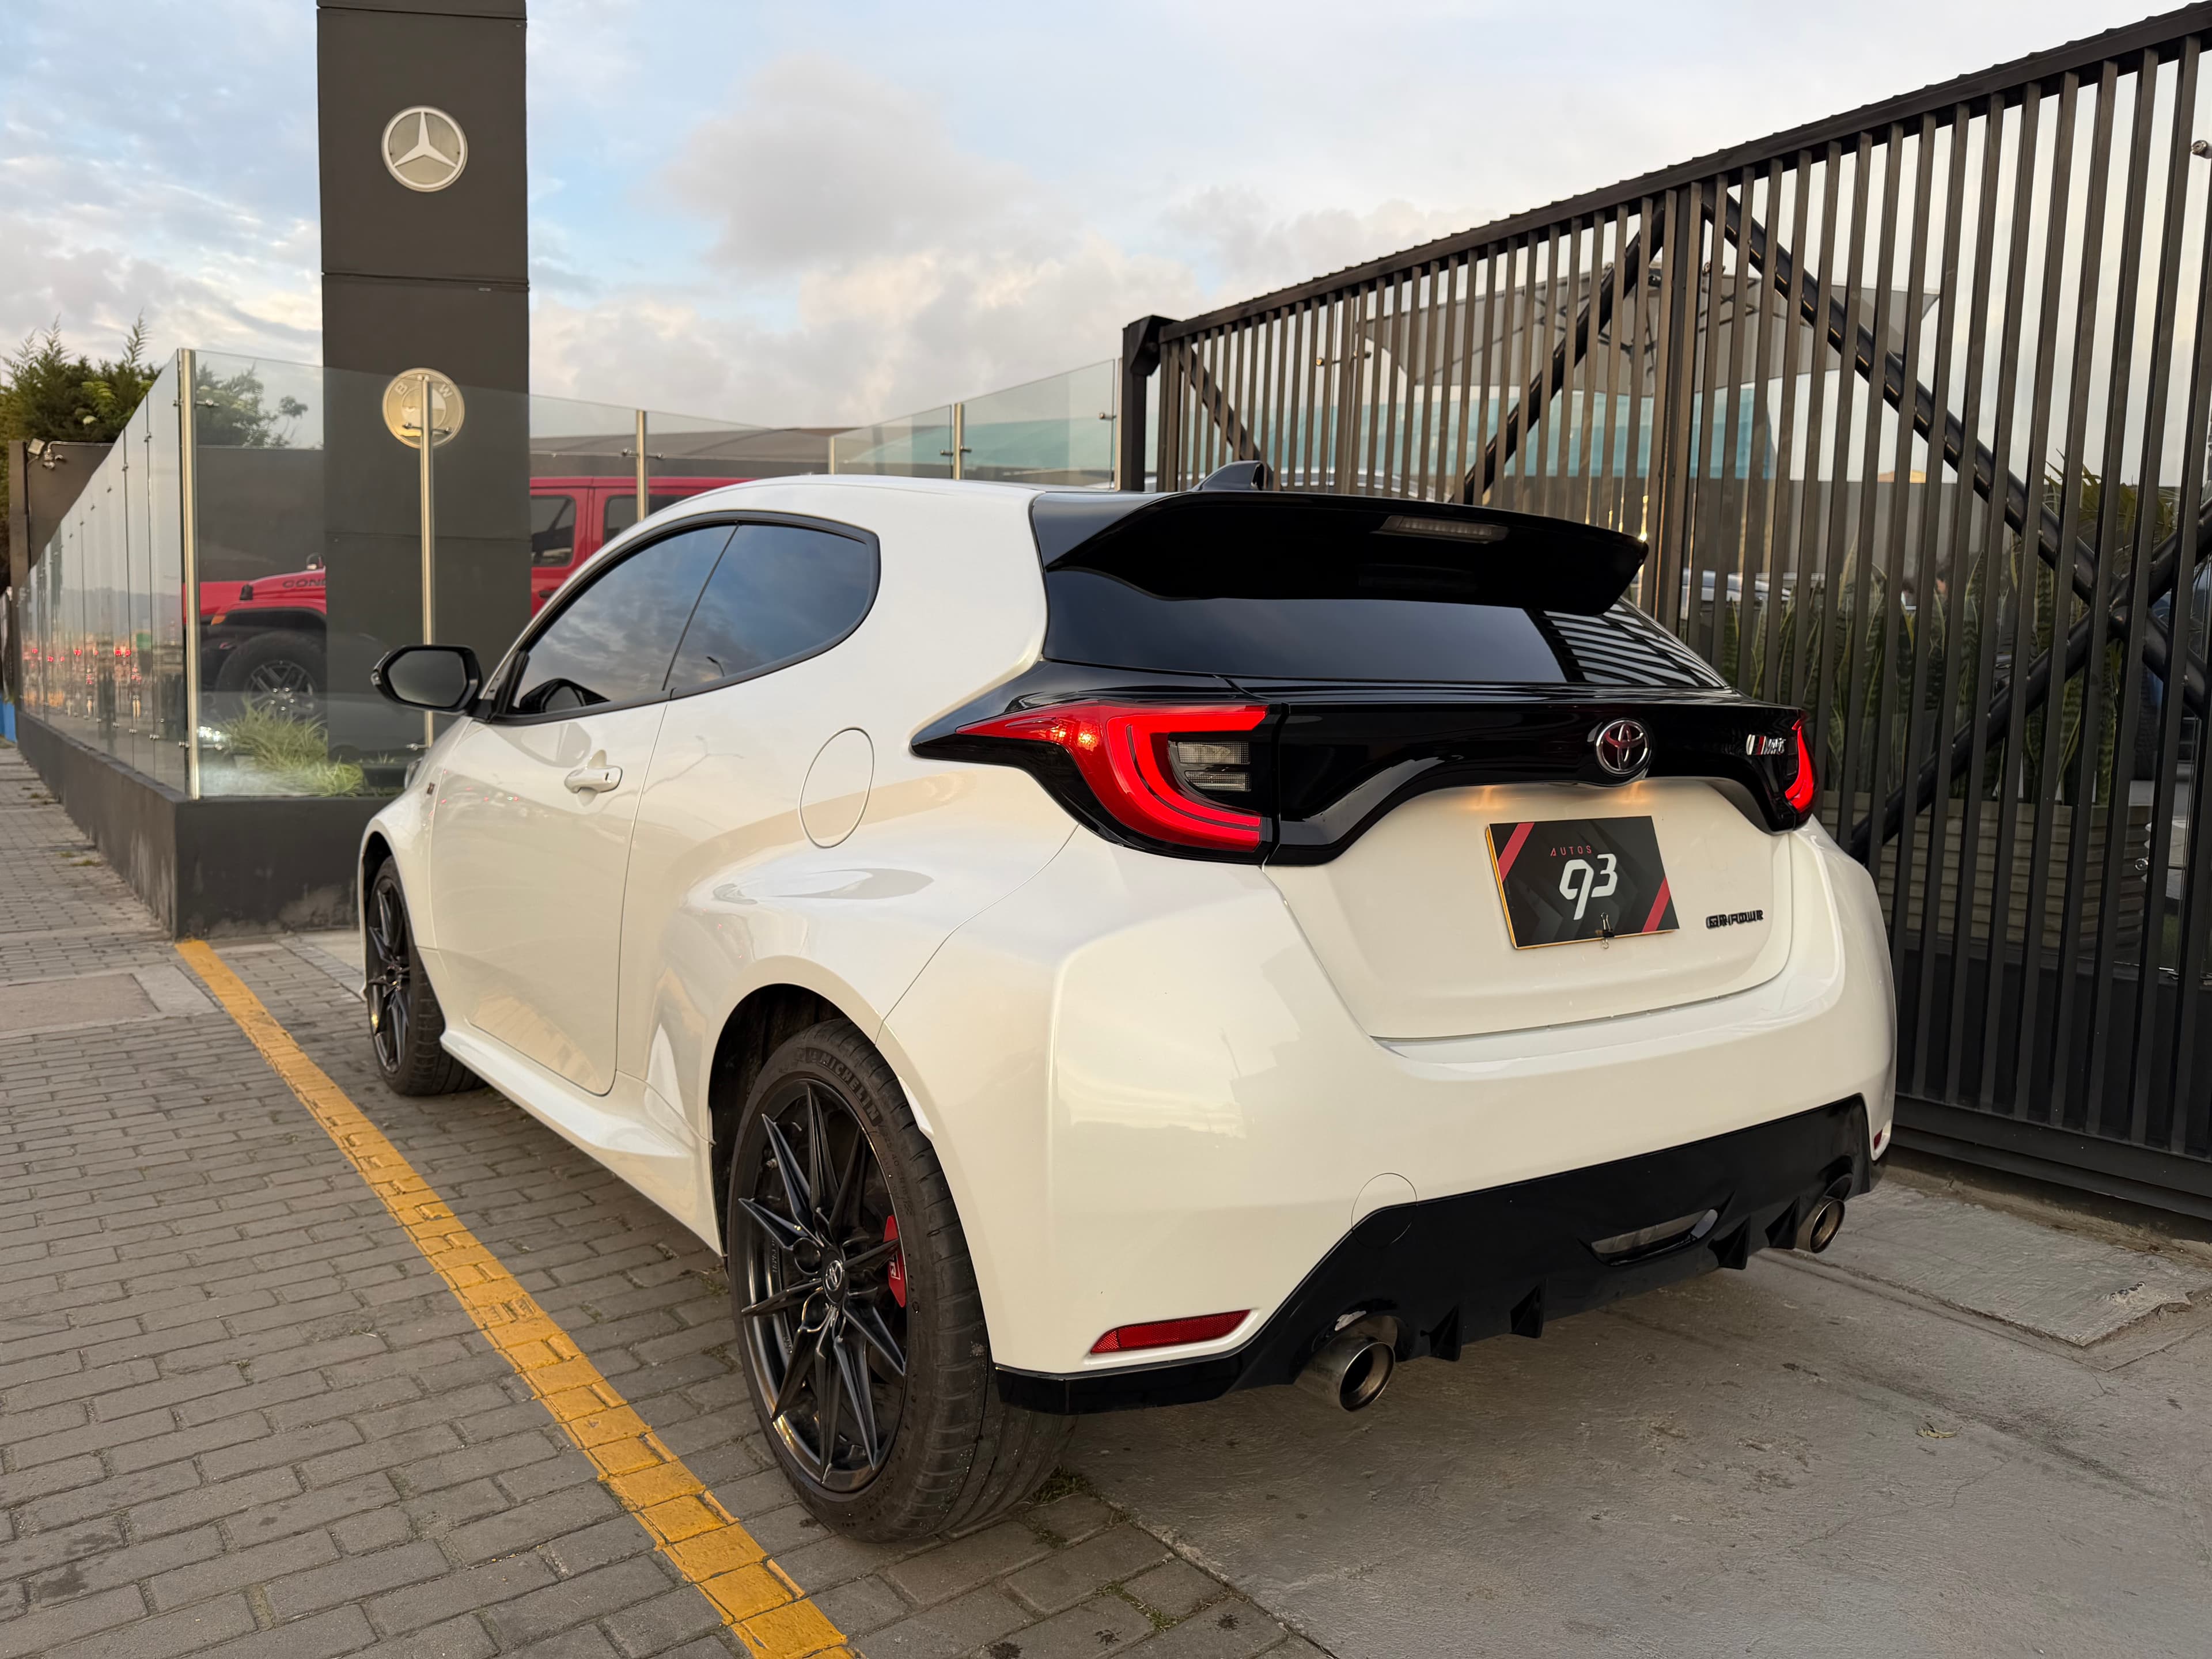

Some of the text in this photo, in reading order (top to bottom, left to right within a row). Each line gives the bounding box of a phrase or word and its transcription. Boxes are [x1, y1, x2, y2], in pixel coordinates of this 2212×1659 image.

[1550, 845, 1592, 856] AUTOS
[1559, 853, 1618, 921] 93
[819, 1053, 880, 1122] MICHELIN
